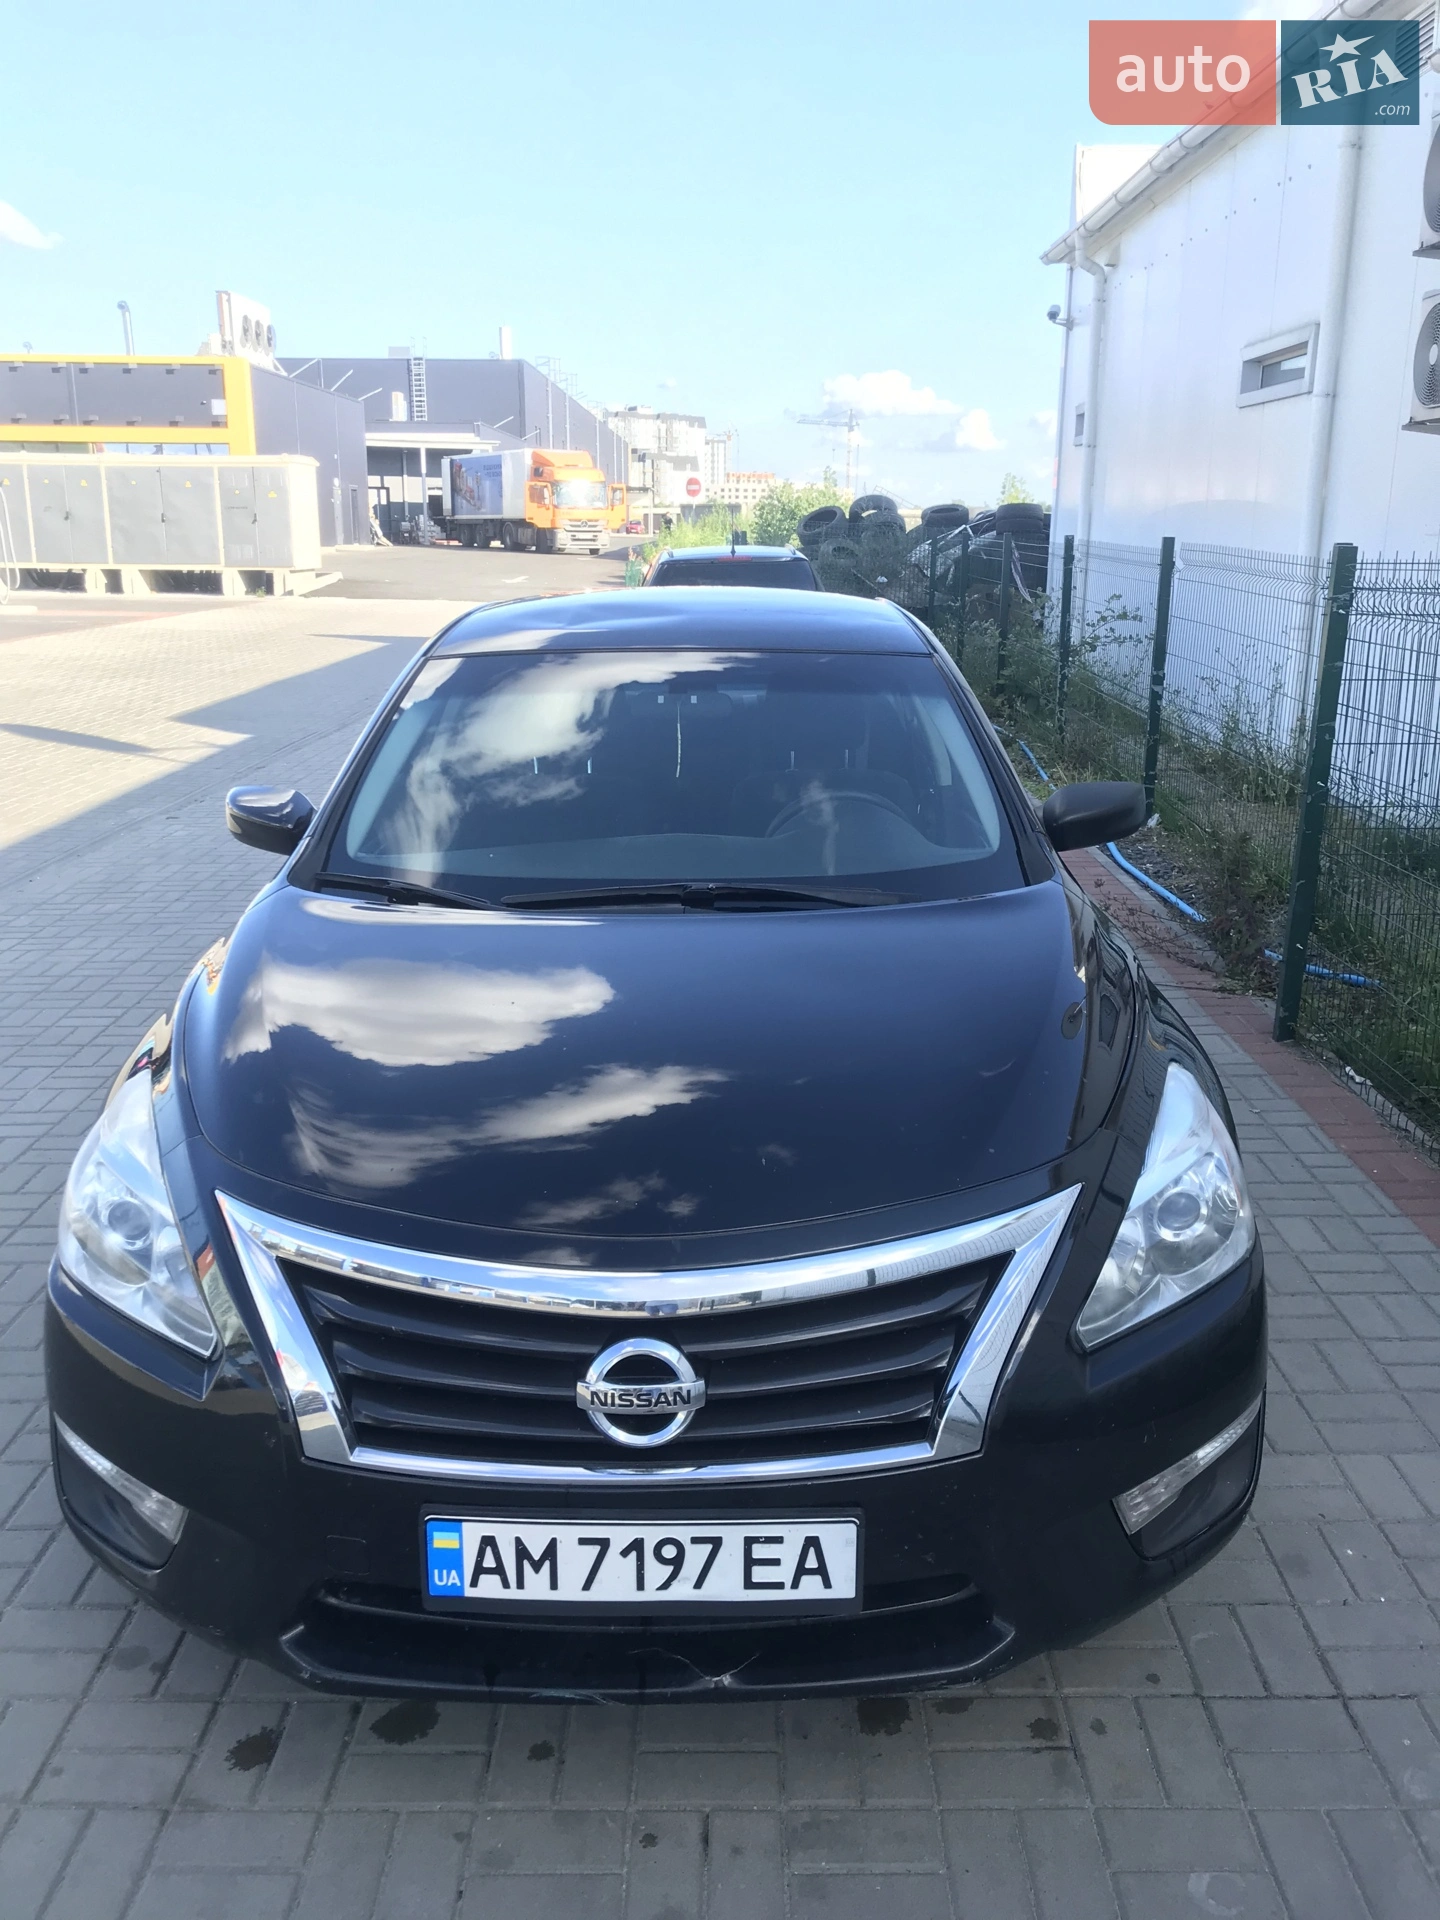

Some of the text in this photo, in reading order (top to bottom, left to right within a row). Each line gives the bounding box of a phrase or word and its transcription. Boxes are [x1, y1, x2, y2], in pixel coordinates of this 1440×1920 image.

[590, 1389, 691, 1408] NISSAN
[469, 1535, 833, 1591] AM 7197 EA
[434, 1569, 461, 1586] UA
